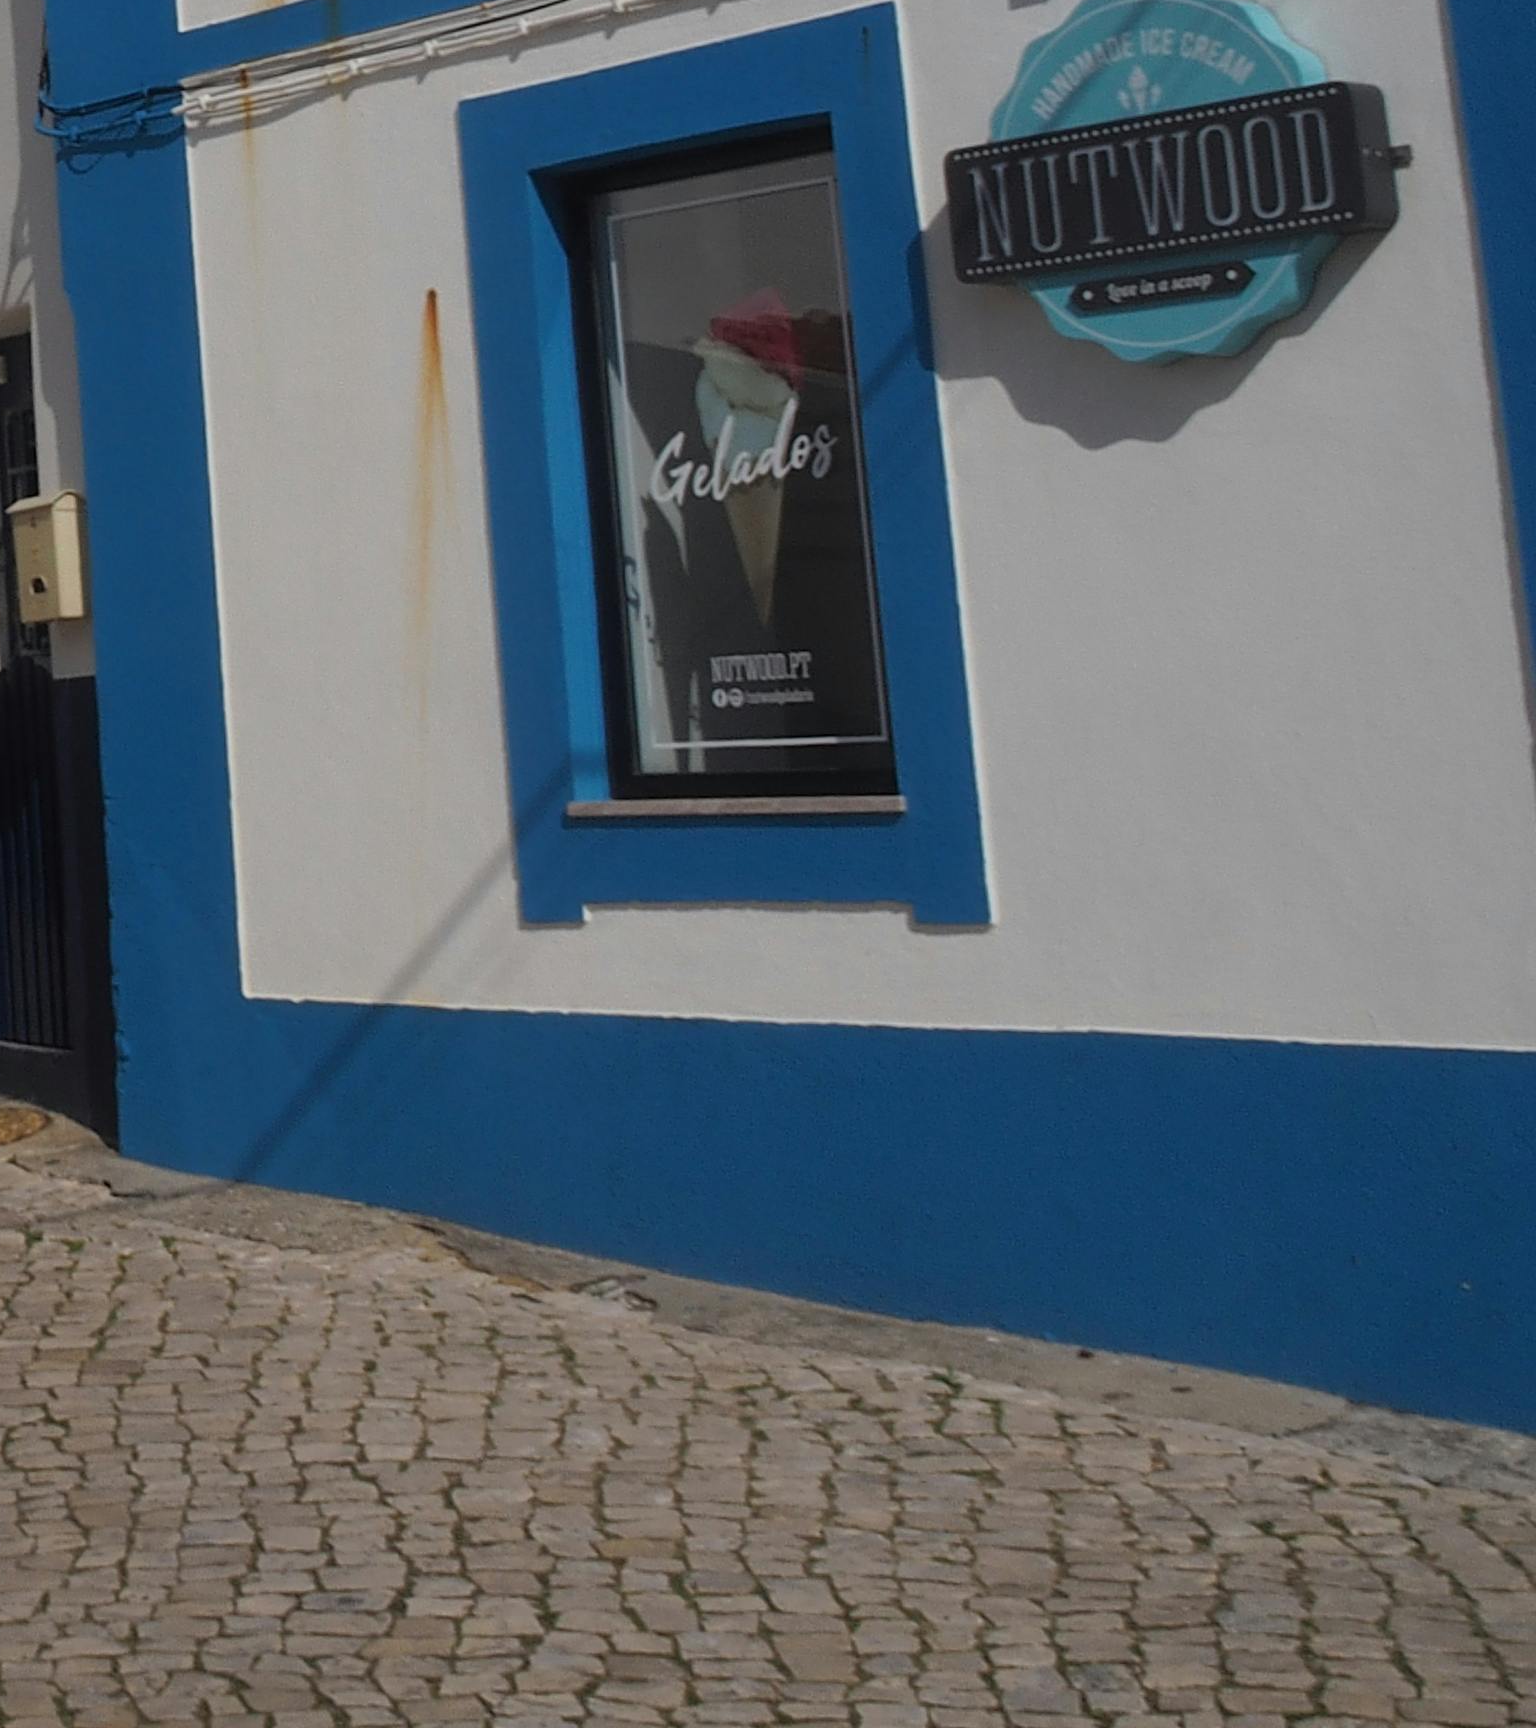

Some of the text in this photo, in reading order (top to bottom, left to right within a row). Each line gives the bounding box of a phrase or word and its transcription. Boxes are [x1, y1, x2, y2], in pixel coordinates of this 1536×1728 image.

[1032, 28, 1256, 120] HANDMADE ICE CREAM
[968, 108, 1336, 263] NUTWOOD
[650, 397, 838, 506] Gelados
